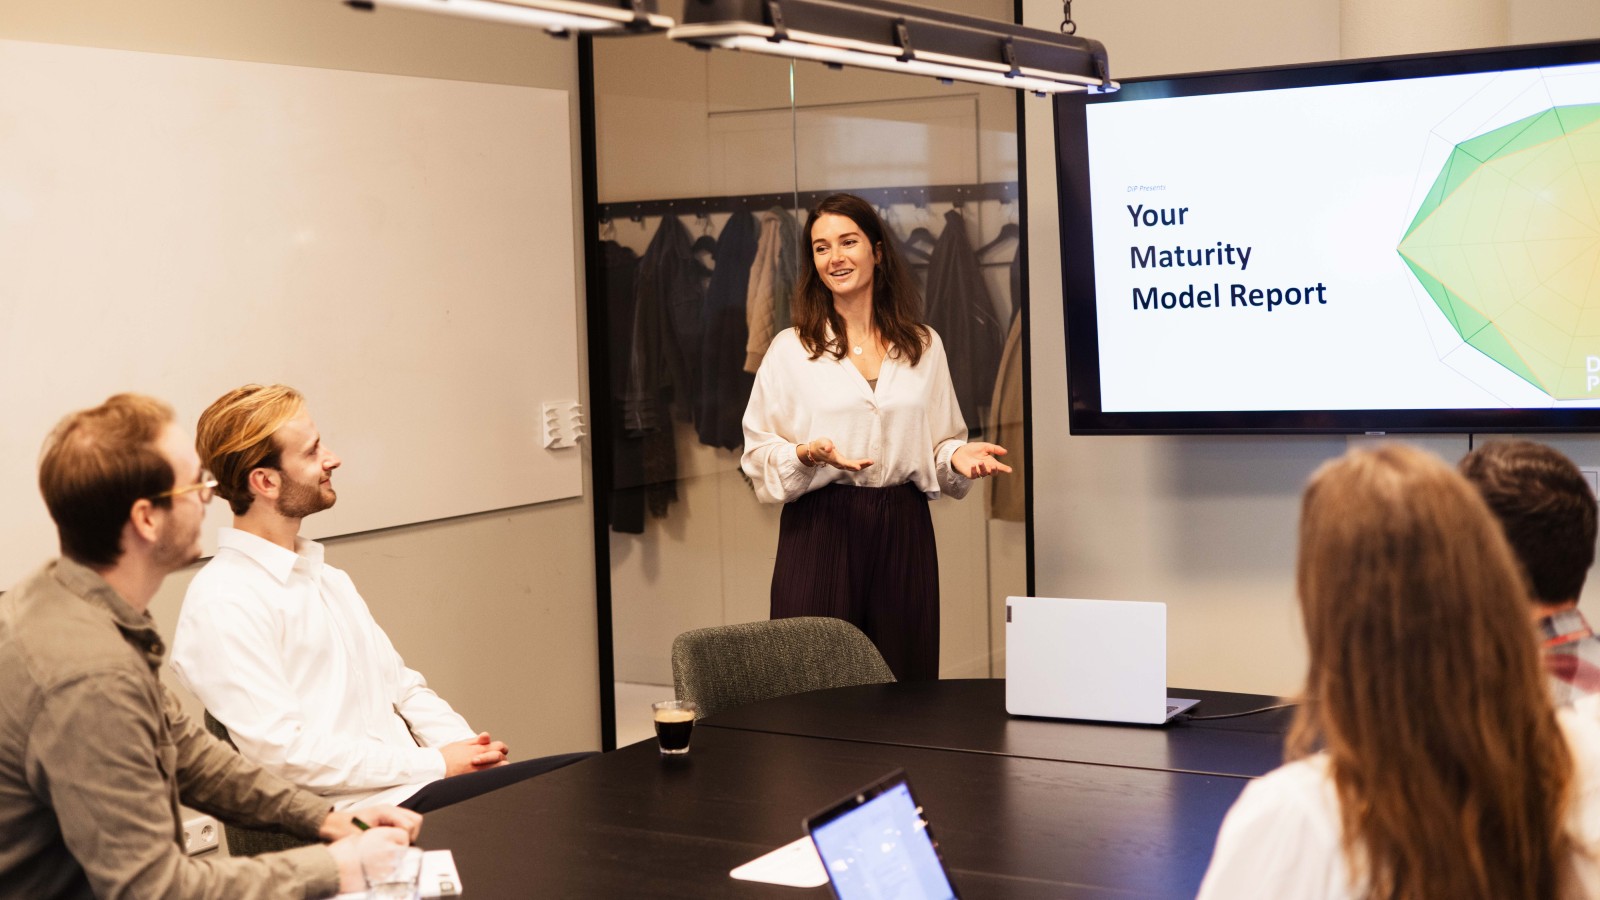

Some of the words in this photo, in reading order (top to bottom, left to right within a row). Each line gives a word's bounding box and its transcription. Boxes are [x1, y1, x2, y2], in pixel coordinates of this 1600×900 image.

[1139, 184, 1166, 192] Presents
[1127, 204, 1189, 227] Your
[1130, 241, 1252, 270] Maturity
[1132, 283, 1220, 310] Model
[1230, 282, 1328, 312] Report
